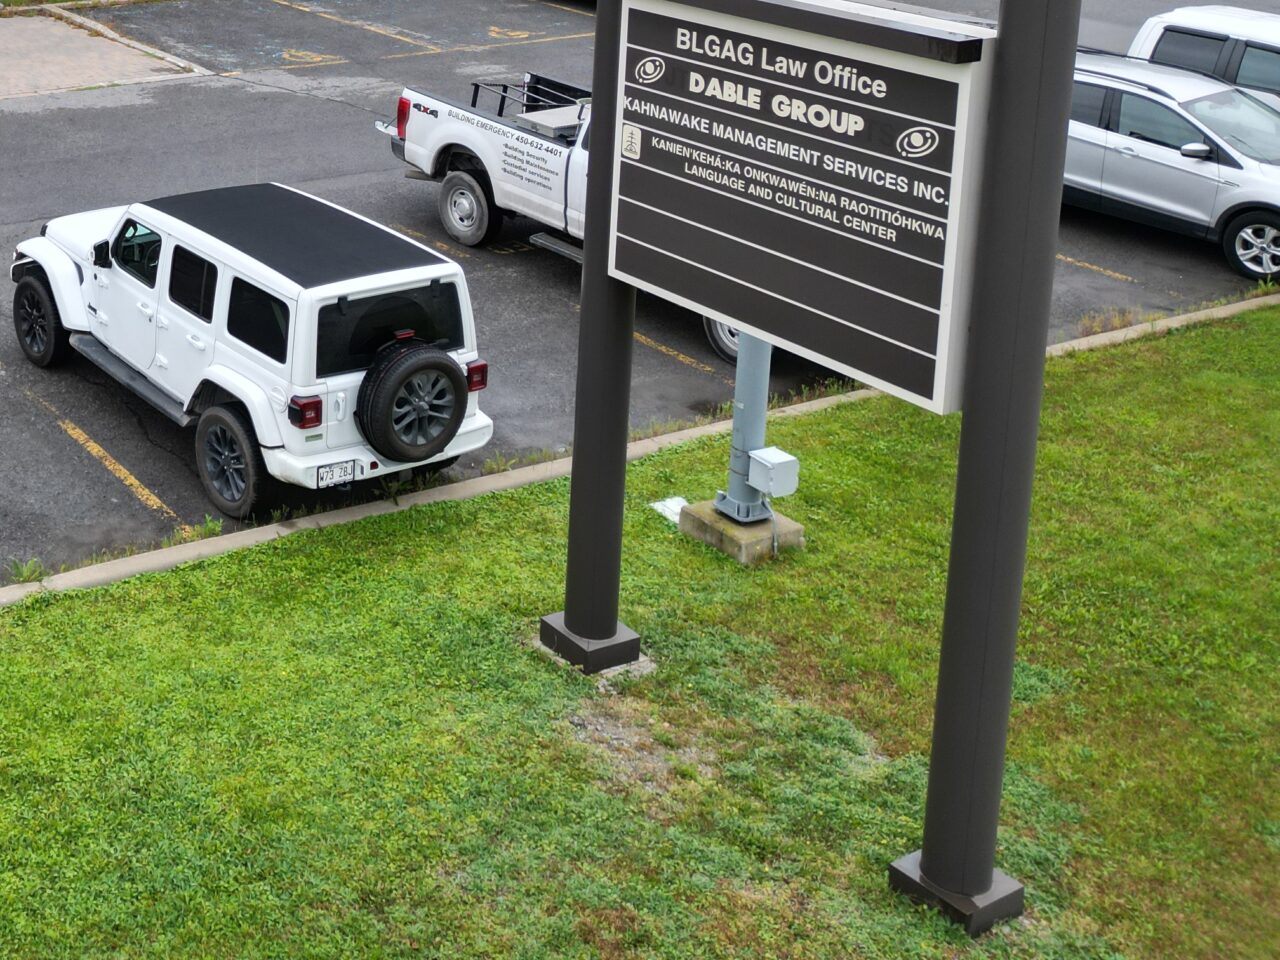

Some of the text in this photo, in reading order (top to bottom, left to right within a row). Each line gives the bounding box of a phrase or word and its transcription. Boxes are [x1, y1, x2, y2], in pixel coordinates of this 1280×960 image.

[676, 28, 887, 98] BLGAG Law Office
[447, 110, 475, 126] BUILDING
[475, 120, 515, 140] EMERGENCY
[689, 72, 762, 110] DABLE
[771, 95, 865, 136] GROUP
[623, 96, 950, 206] KAHNAWAKE MANAGEMENT SERVICES INC.
[684, 162, 897, 242] LANGUAGE AND CULTURAL CENTER
[743, 166, 837, 205] ONKWAWÉN:NA
[840, 196, 945, 240] RAOTITIÓHKWA
